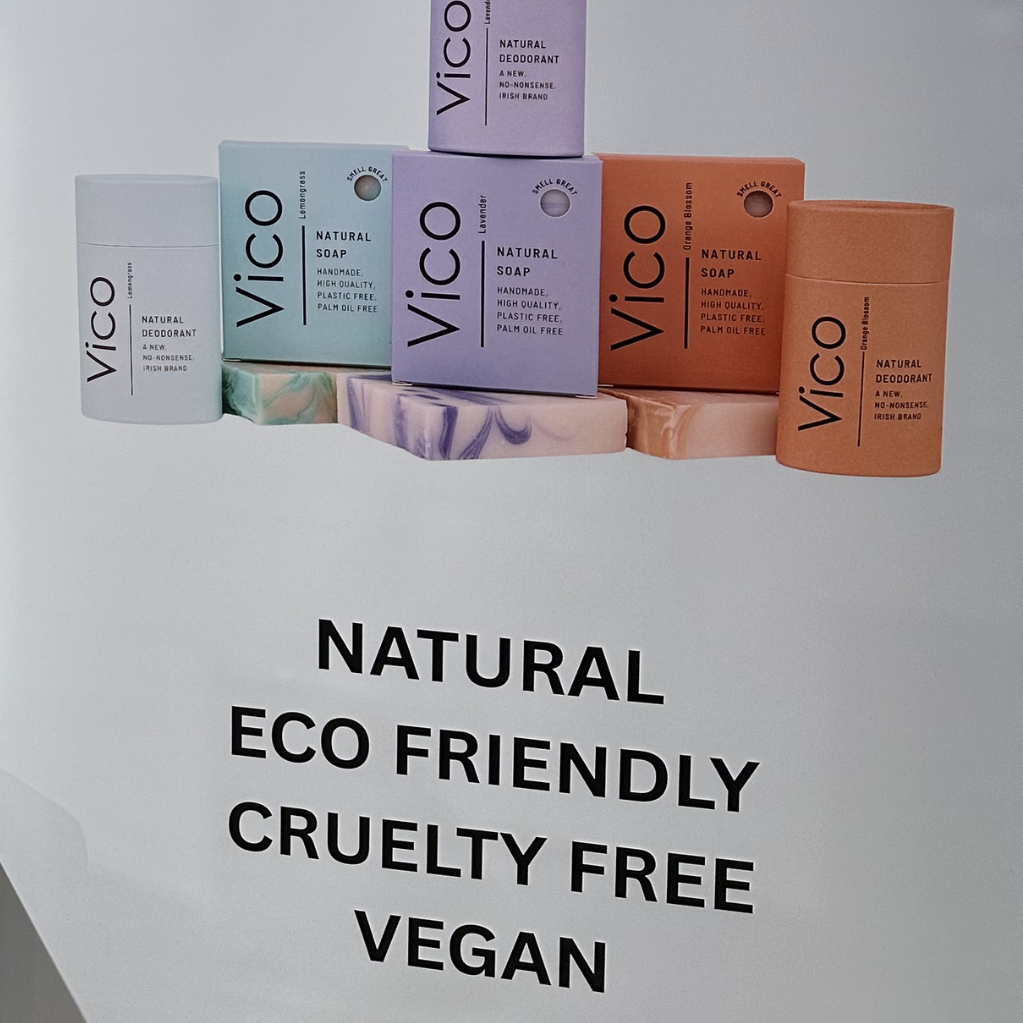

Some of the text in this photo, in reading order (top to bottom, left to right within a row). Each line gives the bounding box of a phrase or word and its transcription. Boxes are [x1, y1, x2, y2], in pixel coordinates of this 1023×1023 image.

[500, 39, 546, 49] NATURAL
[435, 0, 471, 116] Vico
[500, 54, 559, 64] DEODORANT
[500, 92, 548, 101] IRISH BRAND
[346, 166, 388, 183] SMELL GREAT
[532, 178, 578, 195] SMELL GREAT
[737, 180, 782, 199] SMELL GREAT
[478, 194, 487, 234] Lavender
[683, 182, 693, 251] Orange Blossom
[316, 231, 372, 242] NATURAL
[233, 189, 284, 327] Vico
[316, 249, 347, 259] SOAP
[497, 246, 558, 259] NATURAL
[701, 248, 762, 261] NATURAL
[405, 201, 461, 347] Vico
[496, 266, 531, 277] SOAP
[701, 268, 735, 279] SOAP
[317, 279, 336, 288] HIGH
[609, 205, 666, 351] Vico
[317, 291, 350, 300] PLASTIC
[497, 287, 549, 297] HANDMADE,
[317, 303, 378, 313] PALM OIL FREE
[497, 299, 561, 310] HIGH QUALITY,
[701, 301, 765, 311] HIGH QUALITY,
[141, 315, 184, 325] NATURAL
[497, 312, 562, 323] PLASTIC FREE,
[700, 313, 738, 322] PLASTIC
[860, 296, 870, 351] Orange Blossom
[85, 276, 117, 383] Vico
[141, 329, 197, 338] DEODORANT
[497, 324, 563, 335] PALM OIL FREE
[700, 326, 766, 336] PALM OIL FREE
[876, 359, 921, 368] NATURAL
[797, 316, 846, 431] Vico
[875, 373, 932, 383] DEODORANT
[318, 617, 664, 705] NATURAL
[231, 705, 760, 813] ECO FRIENDLY
[228, 801, 754, 913] CRUELTY FREE
[353, 909, 606, 993] VEGAN
